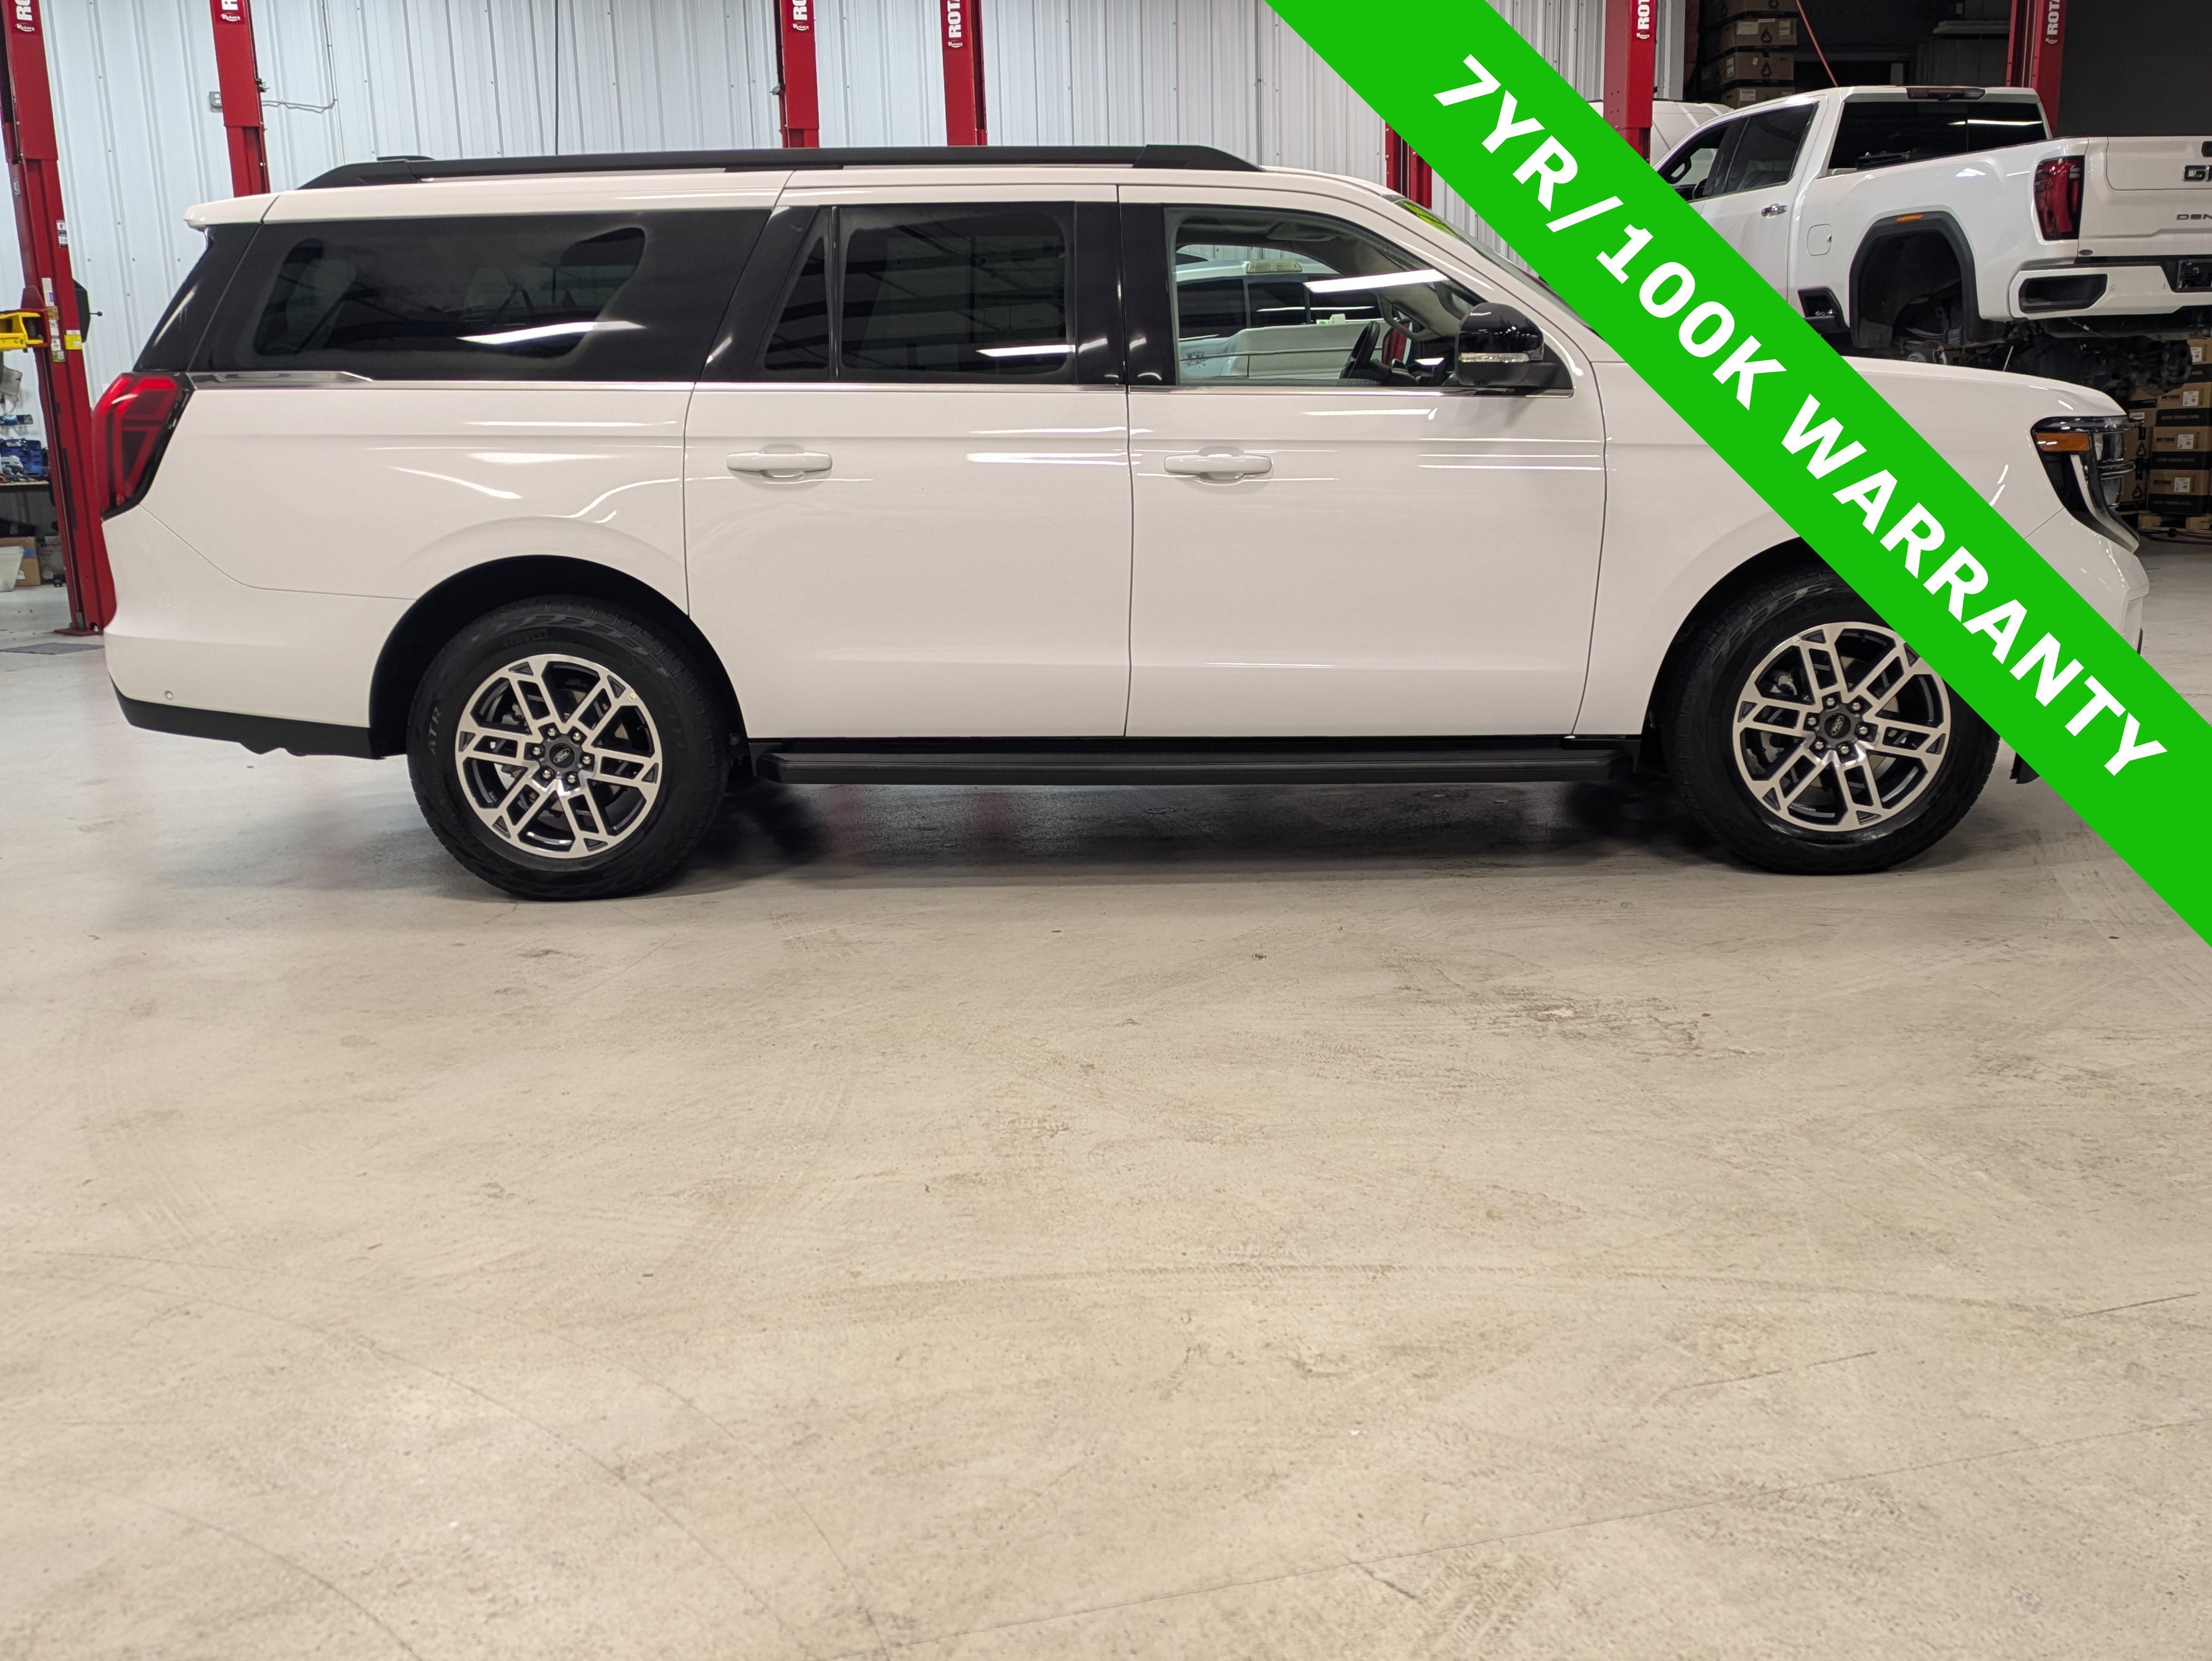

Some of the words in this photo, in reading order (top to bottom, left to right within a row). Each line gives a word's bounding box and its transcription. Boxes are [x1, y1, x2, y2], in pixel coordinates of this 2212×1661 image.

[947, 0, 962, 38] ROT
[2047, 0, 2060, 35] ROT
[2181, 165, 2212, 182] G
